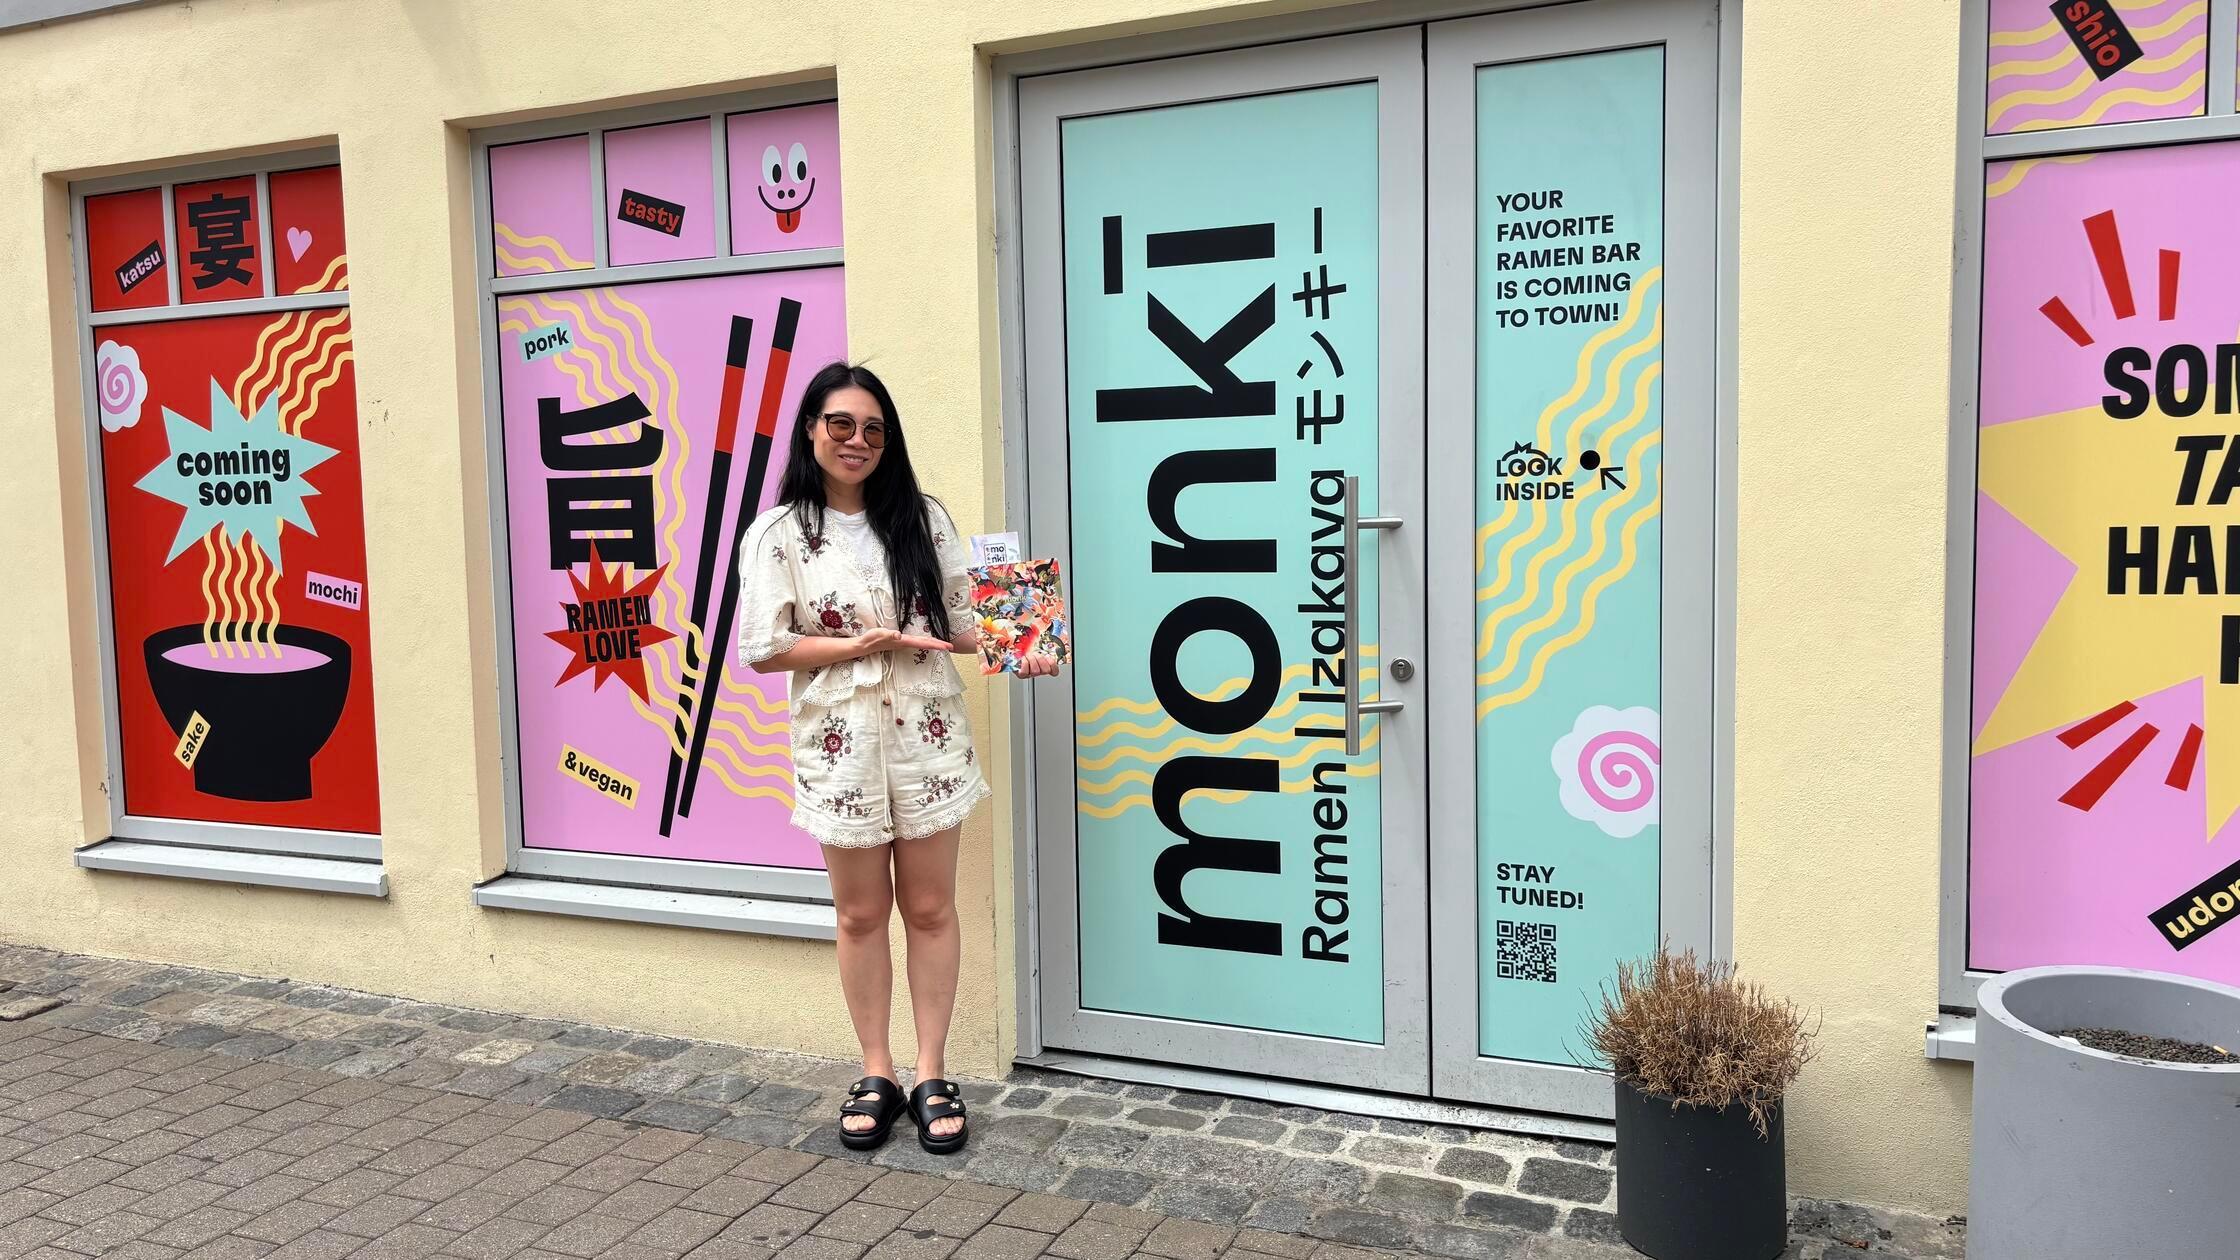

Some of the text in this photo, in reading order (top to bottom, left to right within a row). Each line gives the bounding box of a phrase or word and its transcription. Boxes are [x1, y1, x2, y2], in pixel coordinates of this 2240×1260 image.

[2065, 1, 2120, 67] shio
[625, 197, 680, 233] tasty
[1497, 190, 1563, 213] YOUR
[188, 193, 254, 290] 宴
[1497, 215, 1614, 242] FAVORITE
[120, 249, 161, 288] katsu
[1497, 242, 1641, 271] RAMEN BAR
[1497, 272, 1631, 300] IS COMING
[1292, 206, 1347, 445] モンキー
[1496, 302, 1619, 328] TO TOWN!
[524, 327, 570, 360] pork
[176, 442, 291, 482] coming
[1496, 457, 1563, 478] LOOK
[198, 480, 272, 506] soon
[1496, 481, 1574, 501] INSIDE
[308, 580, 358, 604] mochi
[1297, 469, 1346, 704] Izakaya
[566, 595, 652, 633] RAMEN
[583, 629, 642, 663] LOVE
[181, 721, 206, 763] sake
[1302, 762, 1350, 963] Ramen
[1496, 862, 1556, 884] STAY
[1496, 886, 1584, 910] TUNED!
